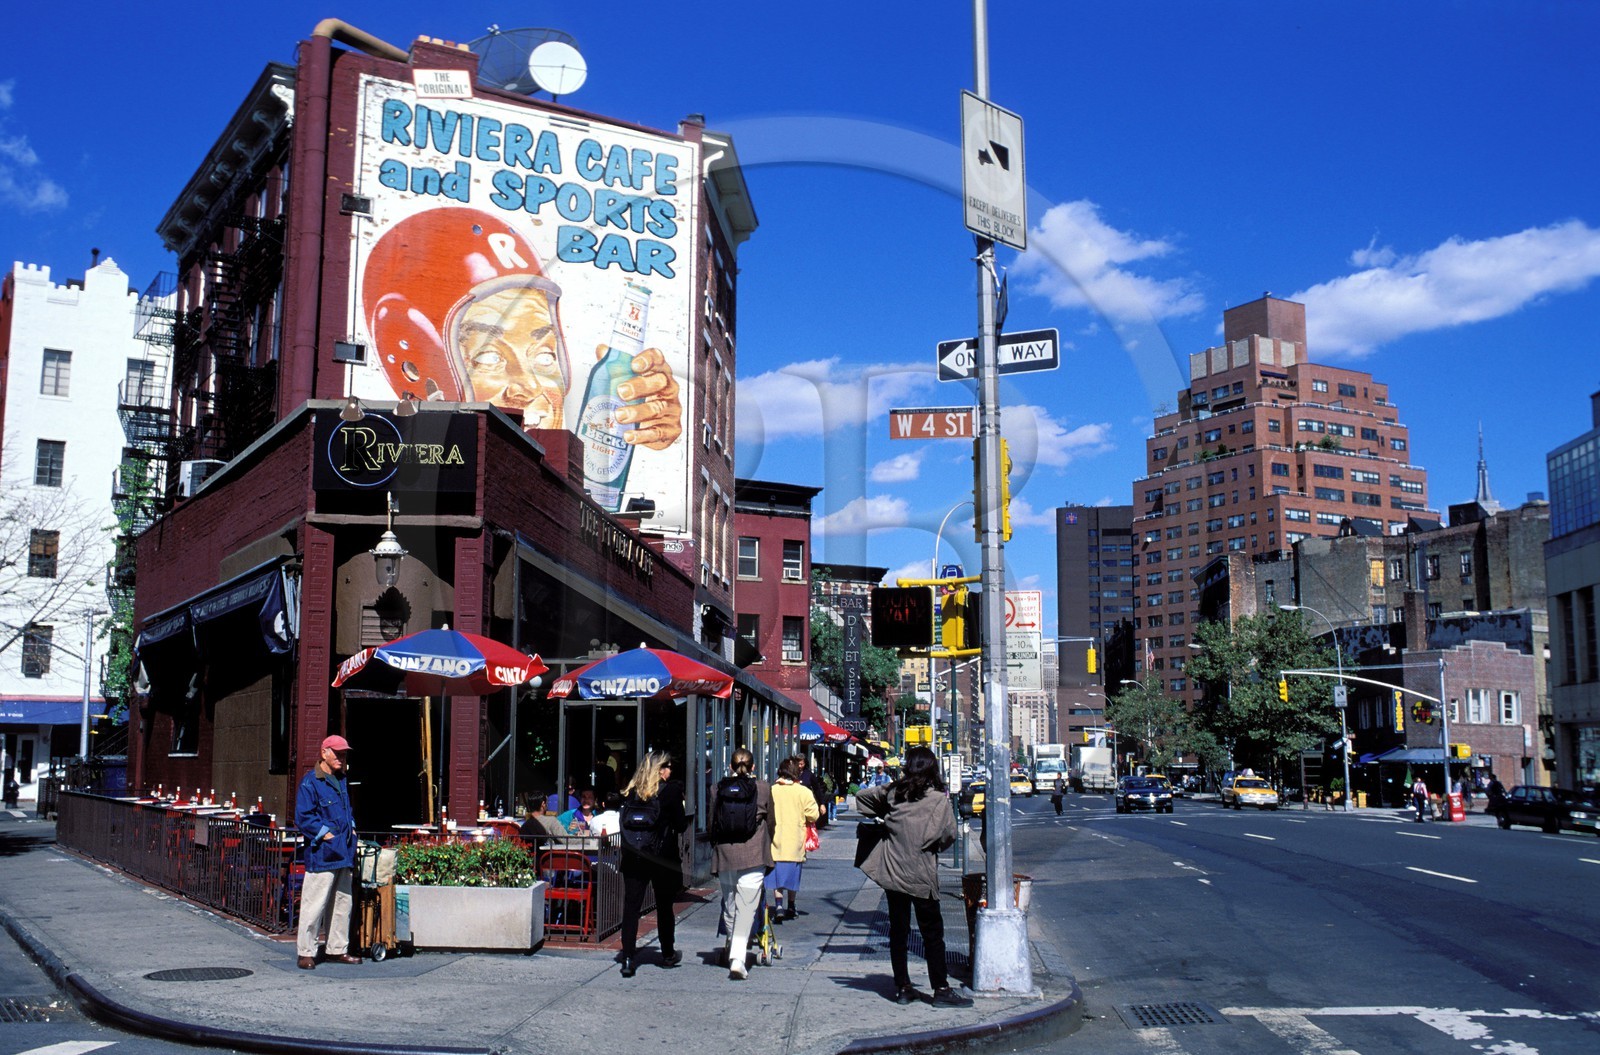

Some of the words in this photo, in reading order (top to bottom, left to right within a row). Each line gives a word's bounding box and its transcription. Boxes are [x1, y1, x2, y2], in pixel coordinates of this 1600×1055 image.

[418, 83, 469, 95] "ORIGINAL"
[433, 72, 450, 82] THE
[381, 98, 562, 175] RIVIERA
[575, 138, 678, 196] CAFE
[378, 157, 471, 203] and
[489, 169, 678, 240] SPORTS
[969, 195, 989, 215] EXCEPT
[991, 205, 1021, 227] DELIVERIES
[977, 213, 991, 230] THIS
[993, 221, 1015, 239] BLOCK
[488, 232, 529, 270] R
[556, 224, 676, 279] BAR
[955, 351, 977, 367] ON
[1011, 342, 1047, 361] WAY
[896, 414, 913, 437] W
[921, 413, 936, 437] 4
[945, 412, 967, 436] ST
[340, 426, 465, 472] RIVIERA
[591, 442, 616, 456] LIGHT
[840, 597, 865, 609] BAR
[388, 654, 472, 676] CINZANO
[590, 677, 660, 696] CINZANO
[838, 720, 867, 733] RESTO
